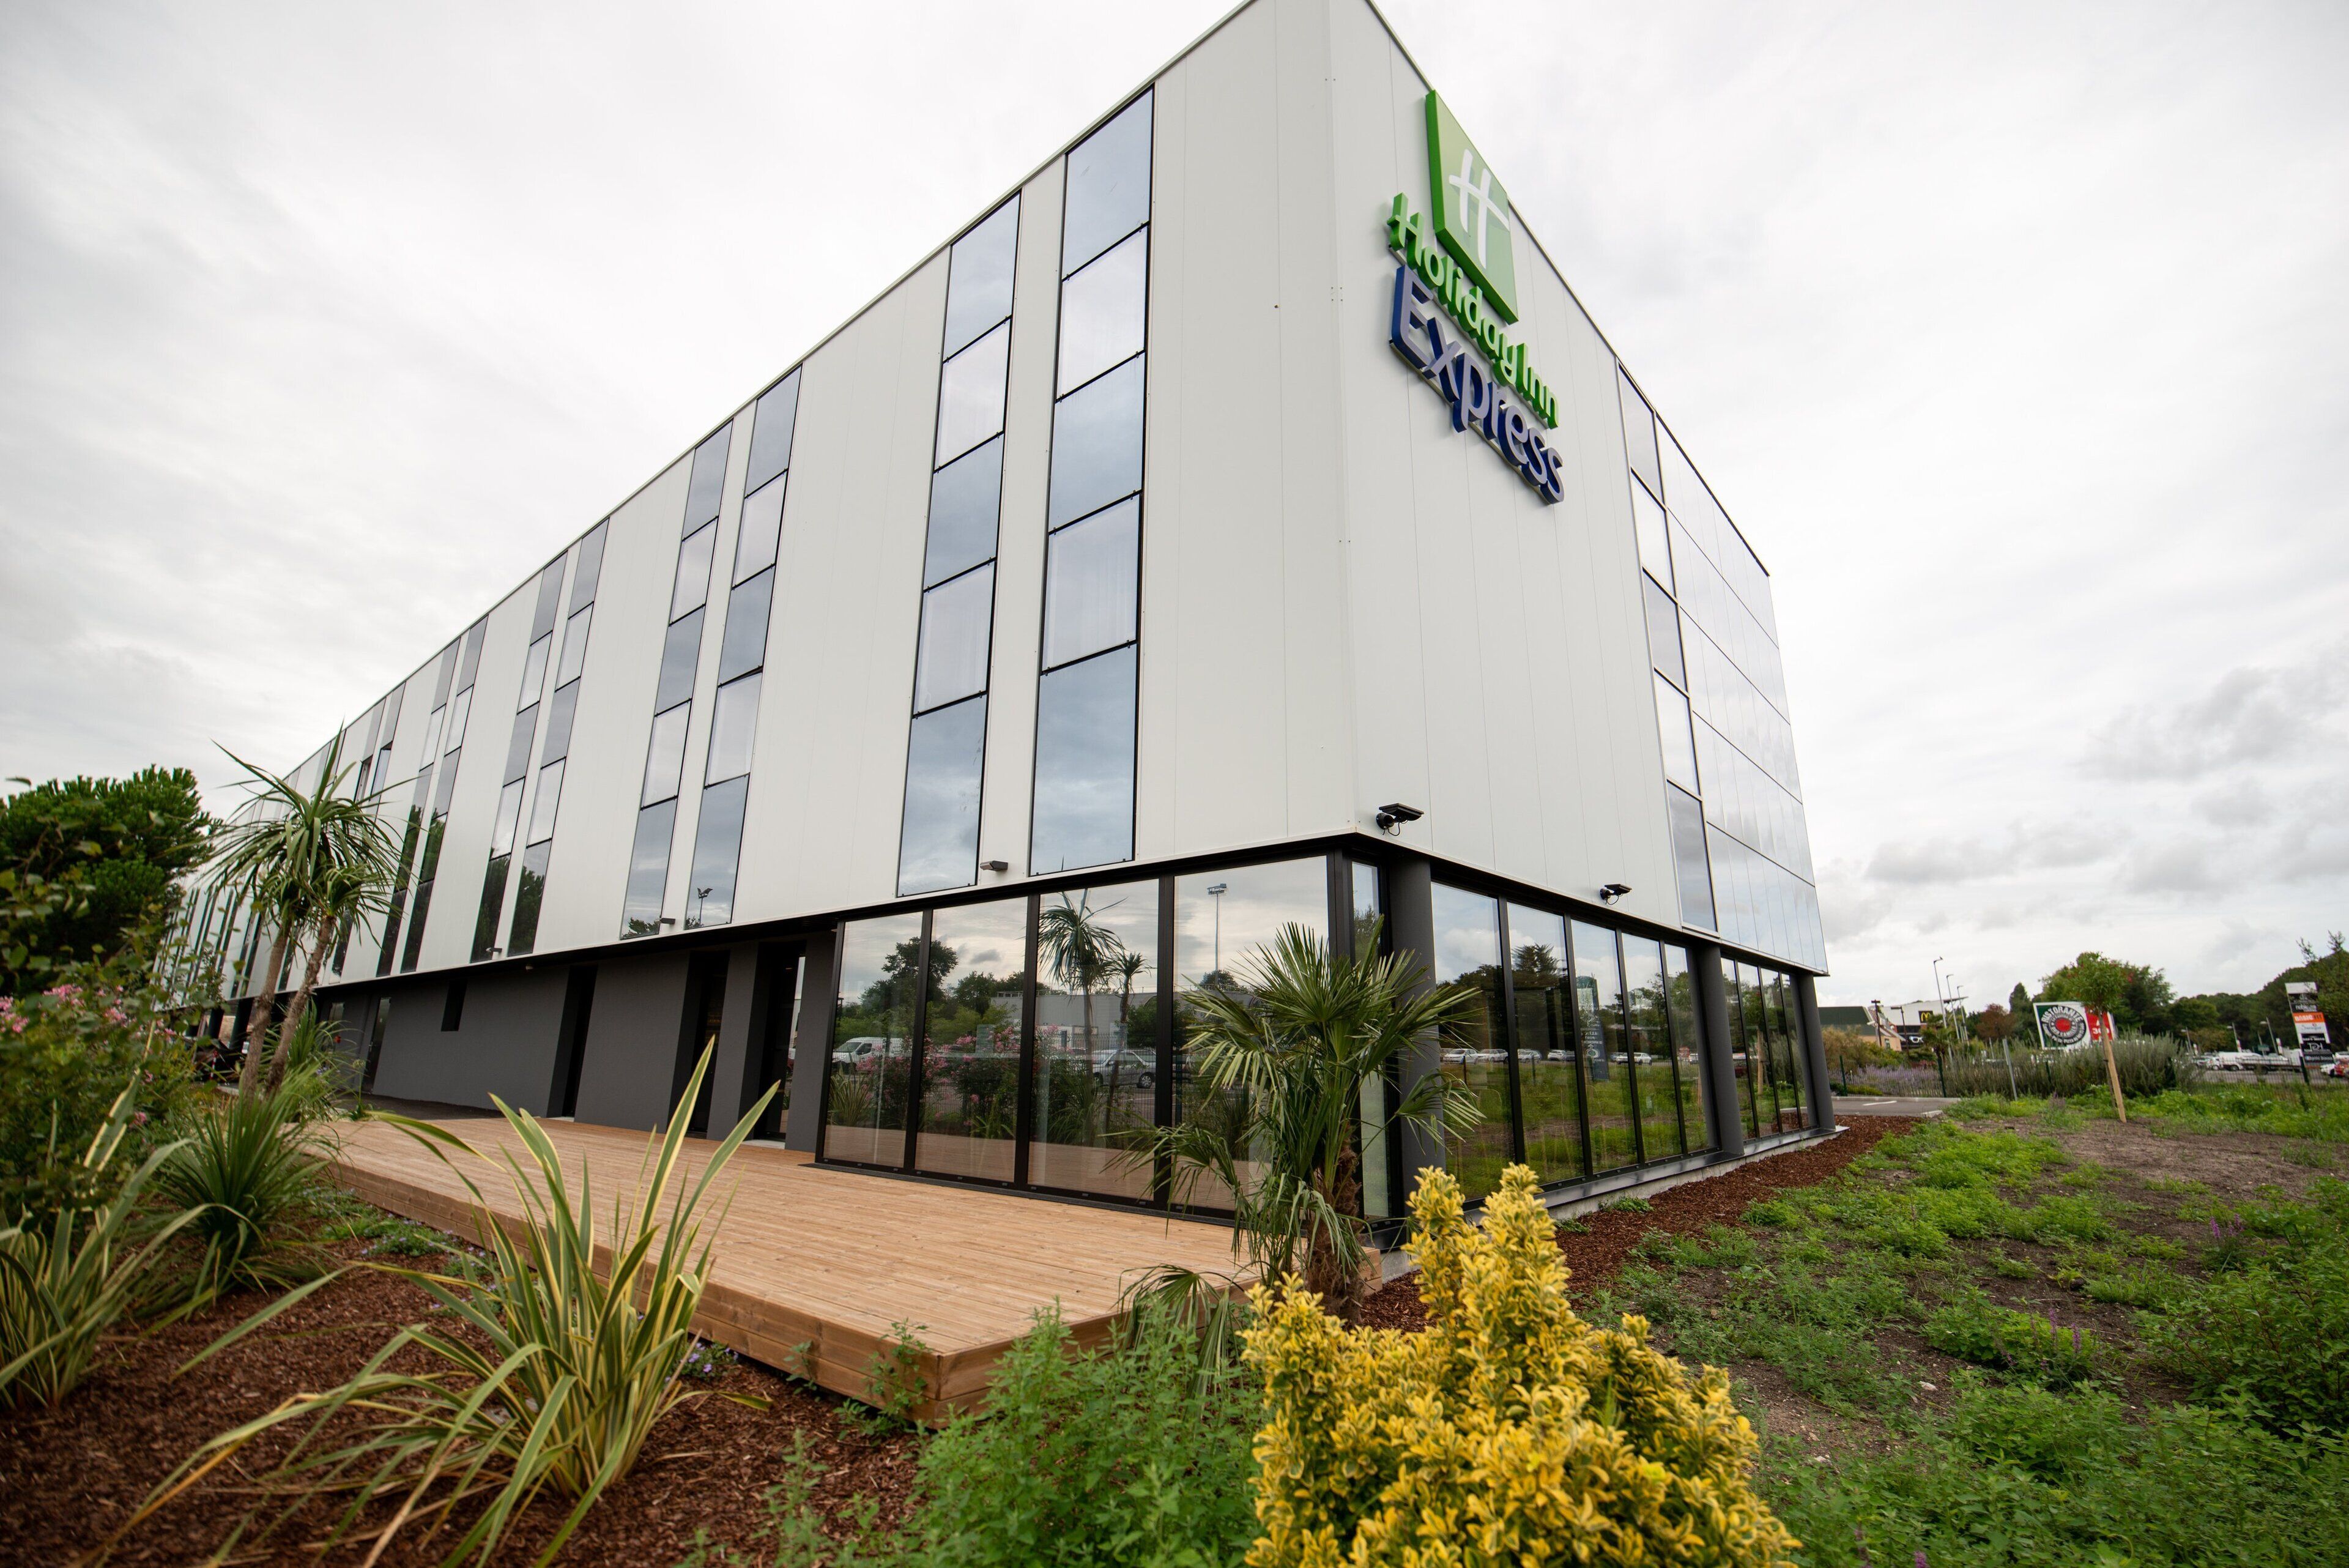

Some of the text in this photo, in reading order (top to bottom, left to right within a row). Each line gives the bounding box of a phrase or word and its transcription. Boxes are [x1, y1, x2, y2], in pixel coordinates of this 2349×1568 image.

[1387, 192, 1559, 429] Holiday Inn
[1392, 264, 1565, 505] Express
[2041, 1006, 2084, 1023] RISTORANTE
